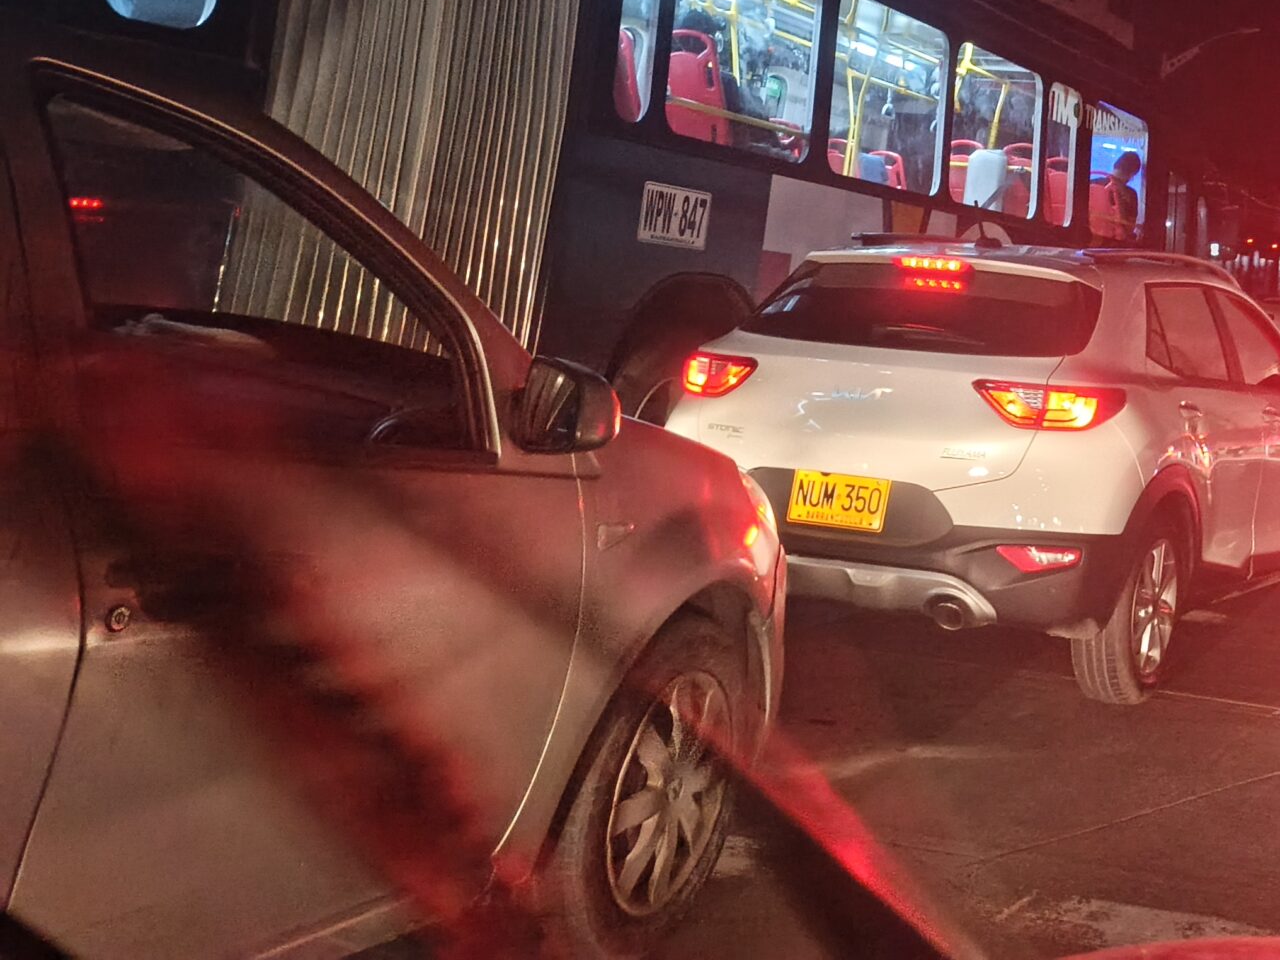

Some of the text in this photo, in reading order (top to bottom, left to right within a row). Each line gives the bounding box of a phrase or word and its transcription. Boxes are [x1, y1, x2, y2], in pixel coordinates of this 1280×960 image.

[643, 189, 708, 239] WPW 847
[795, 479, 882, 515] NUM 350
